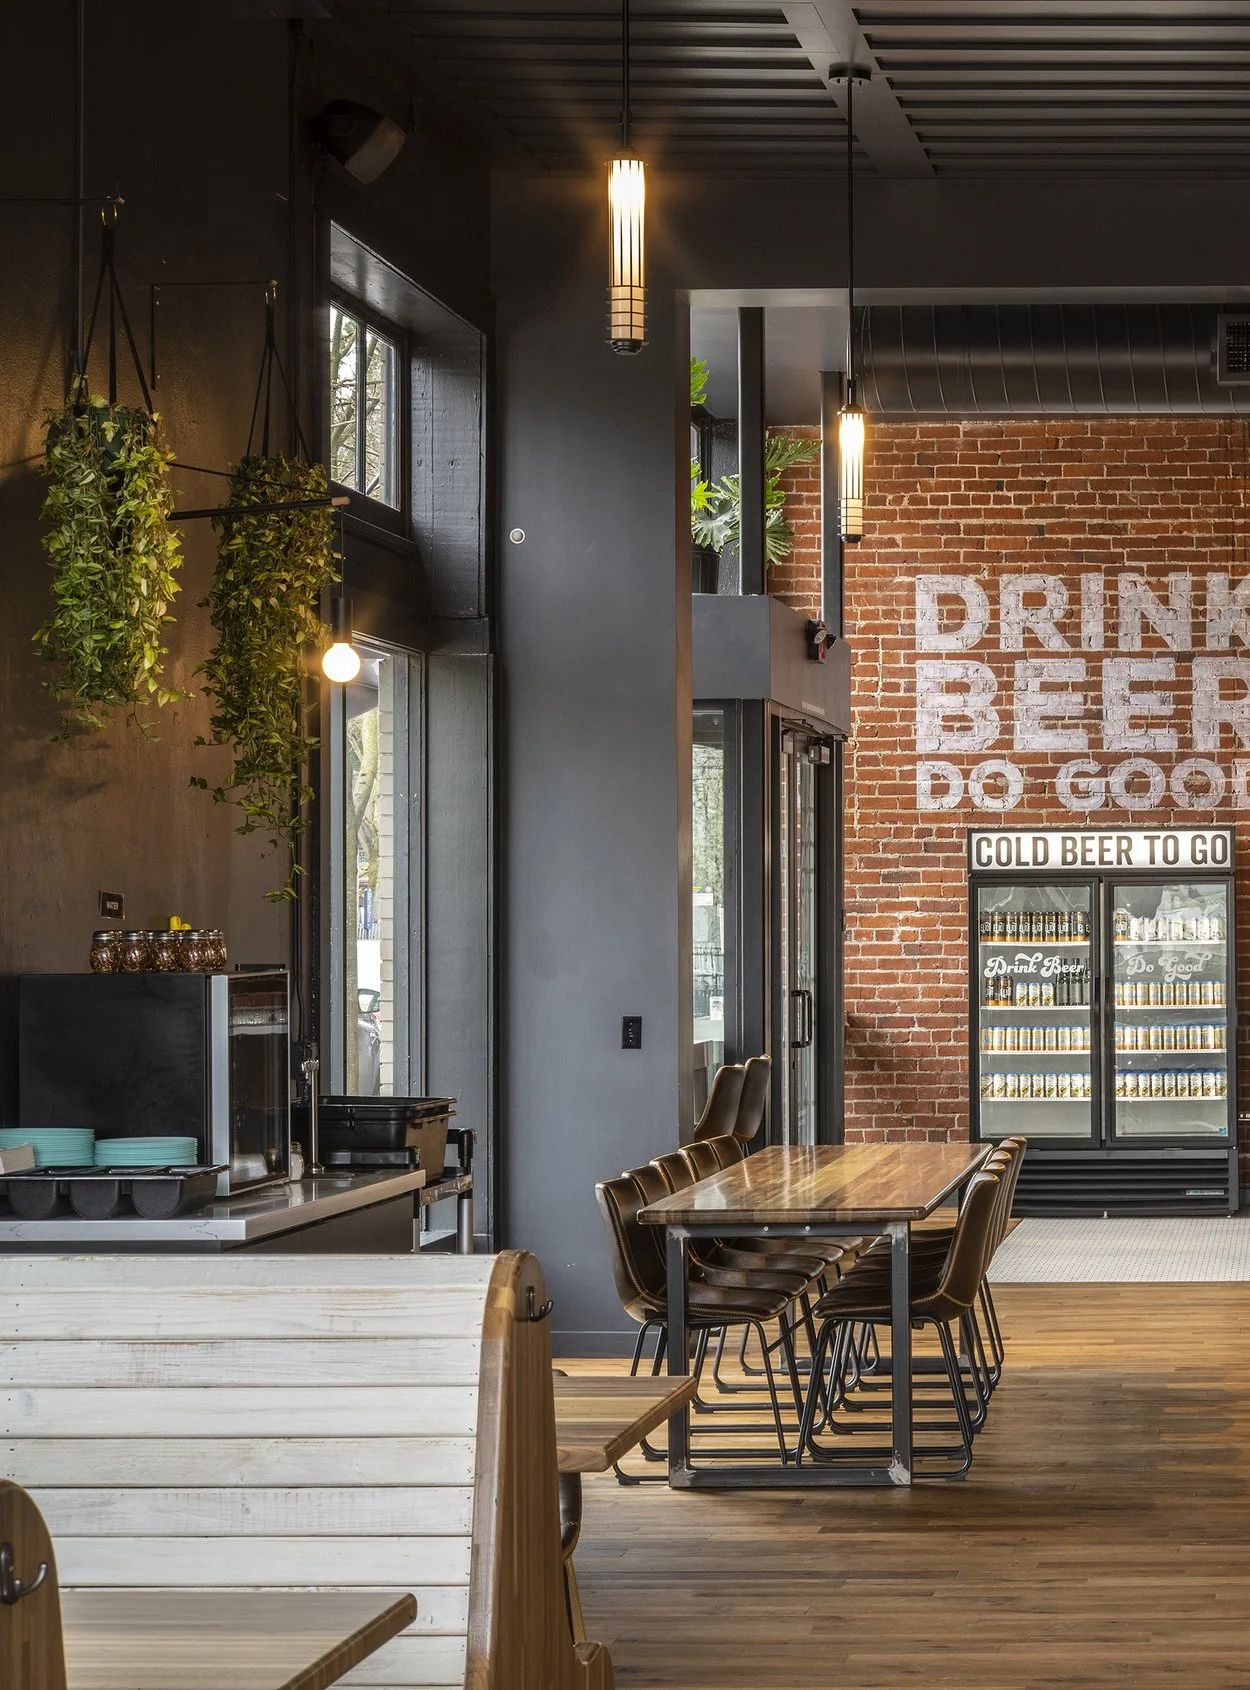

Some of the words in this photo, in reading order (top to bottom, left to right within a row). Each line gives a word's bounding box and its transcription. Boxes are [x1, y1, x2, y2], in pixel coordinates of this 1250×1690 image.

[915, 759, 1024, 811] DO
[975, 836, 1049, 867] COLD
[1060, 834, 1133, 866] BEER
[1144, 834, 1180, 864] TO
[1190, 833, 1229, 864] GO
[984, 953, 1043, 978] Drink
[1040, 955, 1085, 978] Beer
[1126, 955, 1155, 975] Do
[1158, 952, 1213, 982] Good
